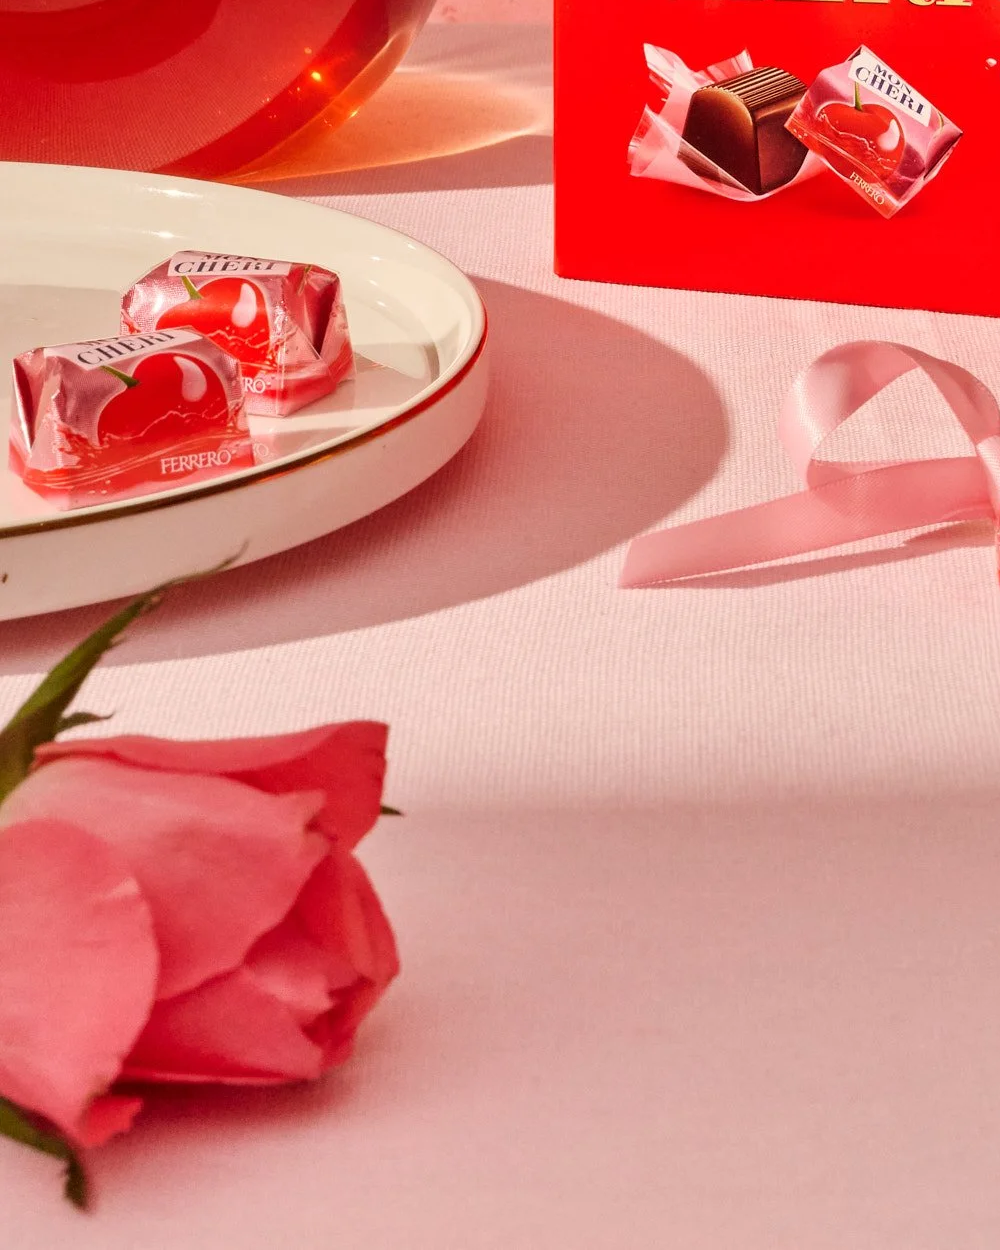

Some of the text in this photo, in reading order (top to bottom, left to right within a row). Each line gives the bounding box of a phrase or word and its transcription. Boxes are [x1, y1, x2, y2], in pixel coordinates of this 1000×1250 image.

[874, 63, 913, 95] MON
[849, 171, 885, 205] FERRERO
[160, 450, 231, 475] FERRERO
